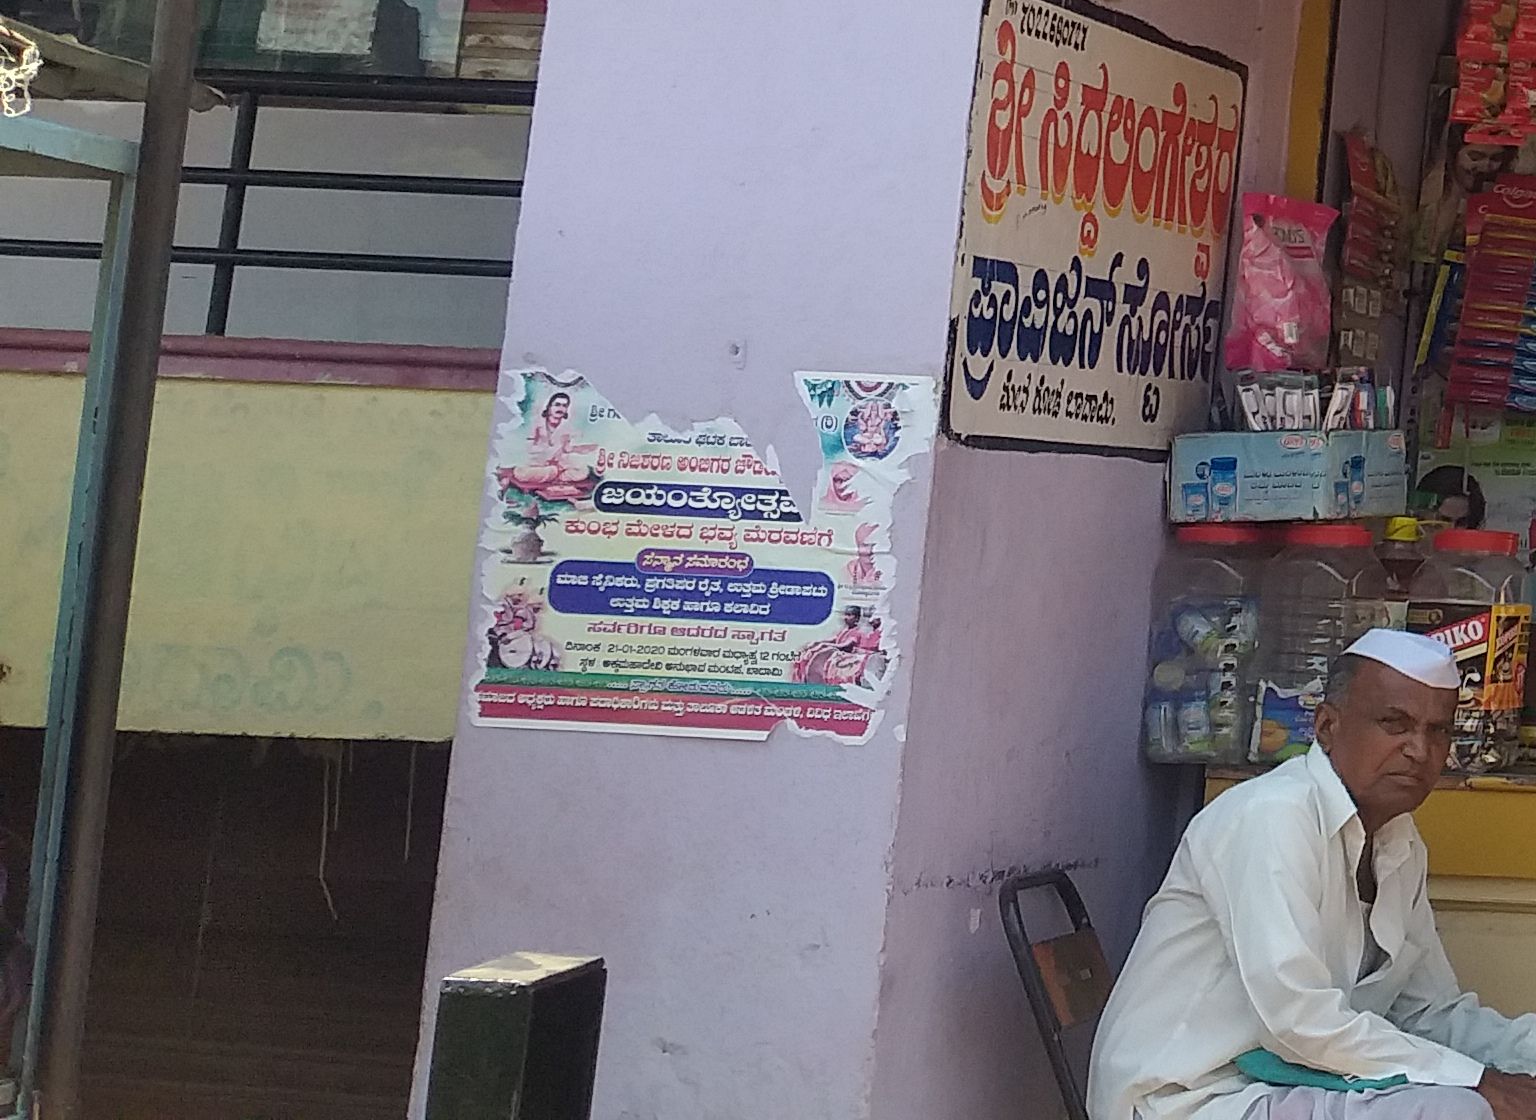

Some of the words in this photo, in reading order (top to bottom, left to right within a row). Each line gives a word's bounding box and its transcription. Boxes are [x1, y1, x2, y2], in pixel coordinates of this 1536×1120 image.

[981, 19, 1035, 227] ಶ್ರೀ
[564, 518, 620, 539] ಕುಂಭ
[625, 520, 694, 541] ಮೇಳದ
[699, 524, 738, 550] ಭವ್ಯ
[607, 643, 665, 655] 21-01-2020
